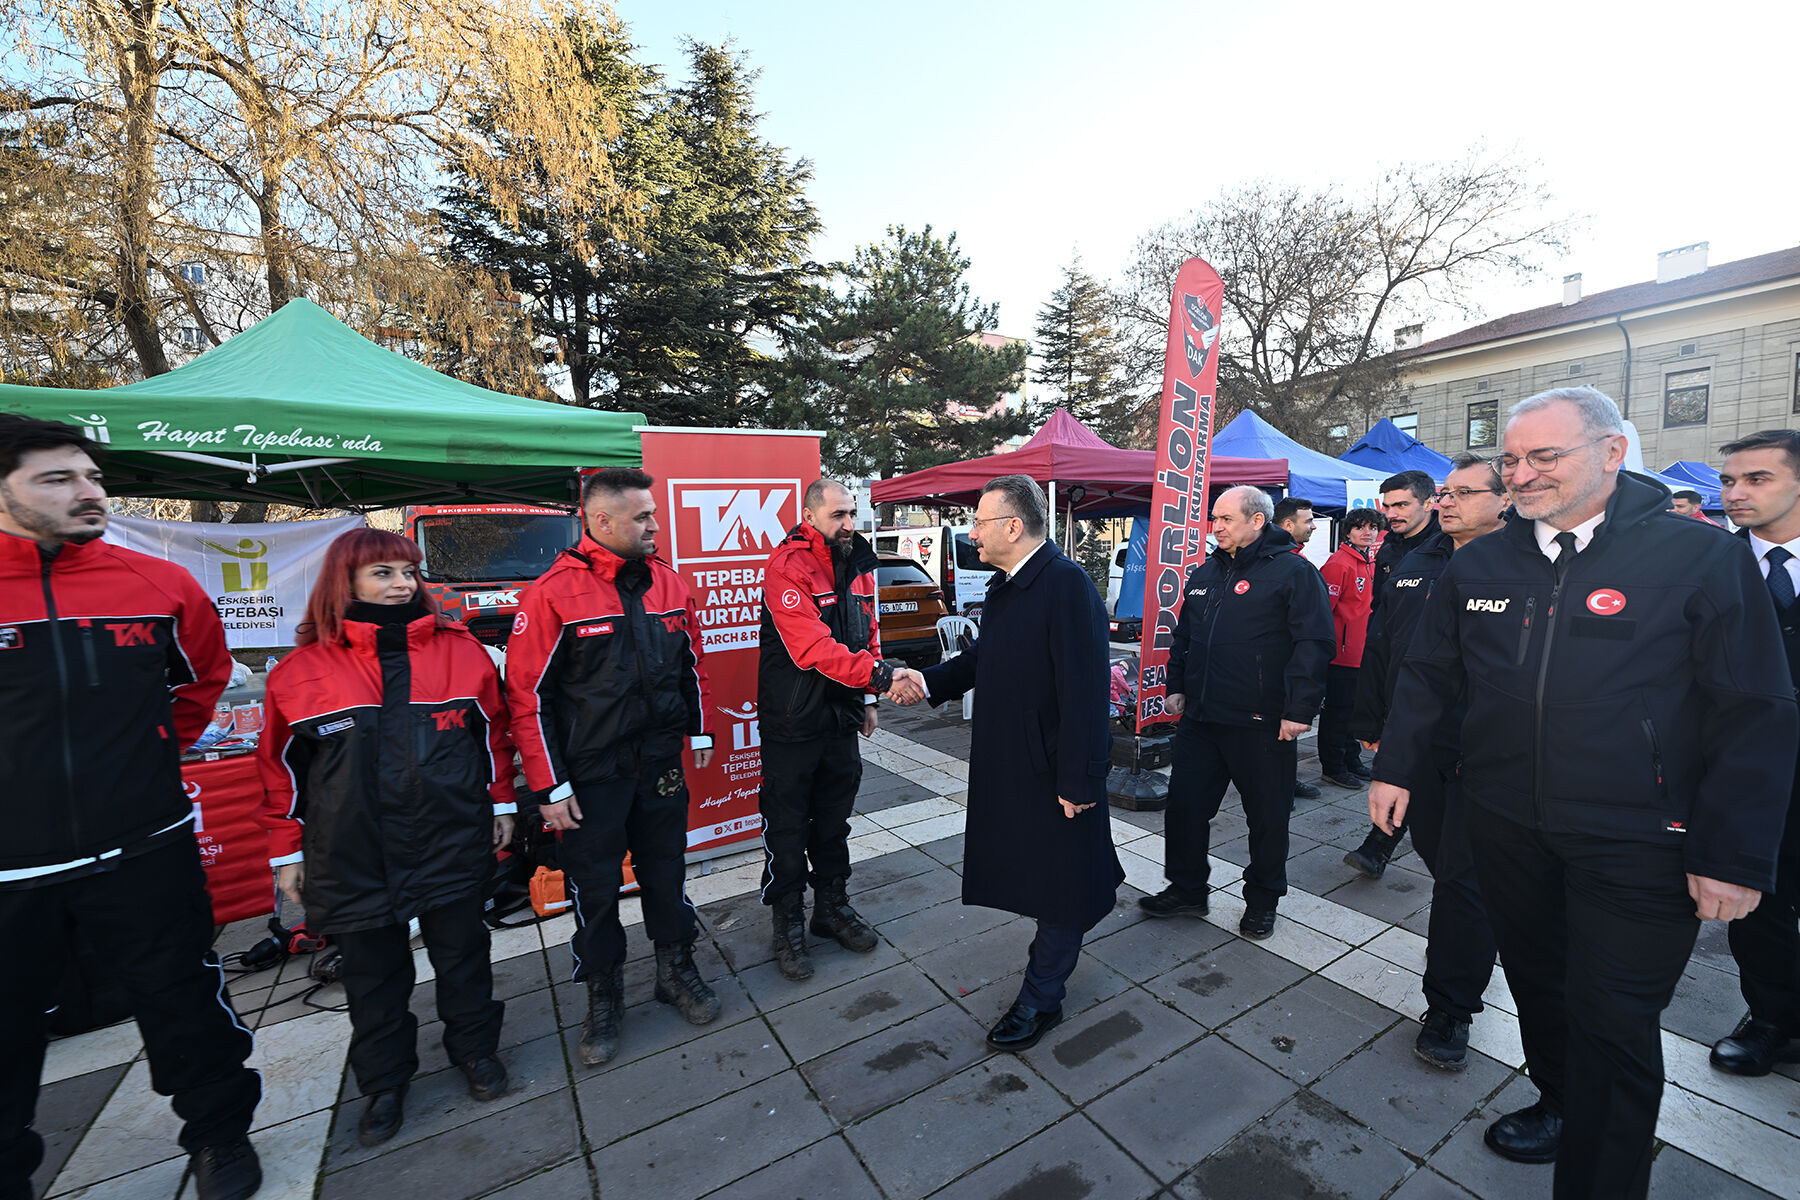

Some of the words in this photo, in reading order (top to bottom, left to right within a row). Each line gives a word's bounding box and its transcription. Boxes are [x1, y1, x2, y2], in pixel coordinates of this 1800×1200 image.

[1187, 345, 1204, 367] DAK
[137, 420, 227, 448] Hayat
[1190, 395, 1212, 522] KURTARMA
[1352, 498, 1386, 513] SAV
[682, 489, 792, 552] TAK
[1186, 527, 1200, 557] VE
[1126, 563, 1146, 573] ŞİŞEC
[692, 567, 765, 588] TEPEBA
[1396, 578, 1423, 588] AFAD
[471, 591, 520, 606] TAK
[705, 586, 763, 607] ARAM
[1189, 587, 1208, 596] AFAD
[217, 595, 275, 605] ESKİŞEHİR
[1466, 598, 1511, 613] AFAD
[217, 607, 284, 620] EPEBAŞI
[224, 621, 275, 630] ELEDİYESİ
[105, 623, 157, 647] TAK
[740, 631, 748, 642] &
[1142, 665, 1167, 691] SEA
[431, 709, 468, 731] TAK
[729, 751, 760, 762] ESKİŞEH
[721, 759, 762, 774] TEPEBA
[734, 783, 761, 799] Tepeb
